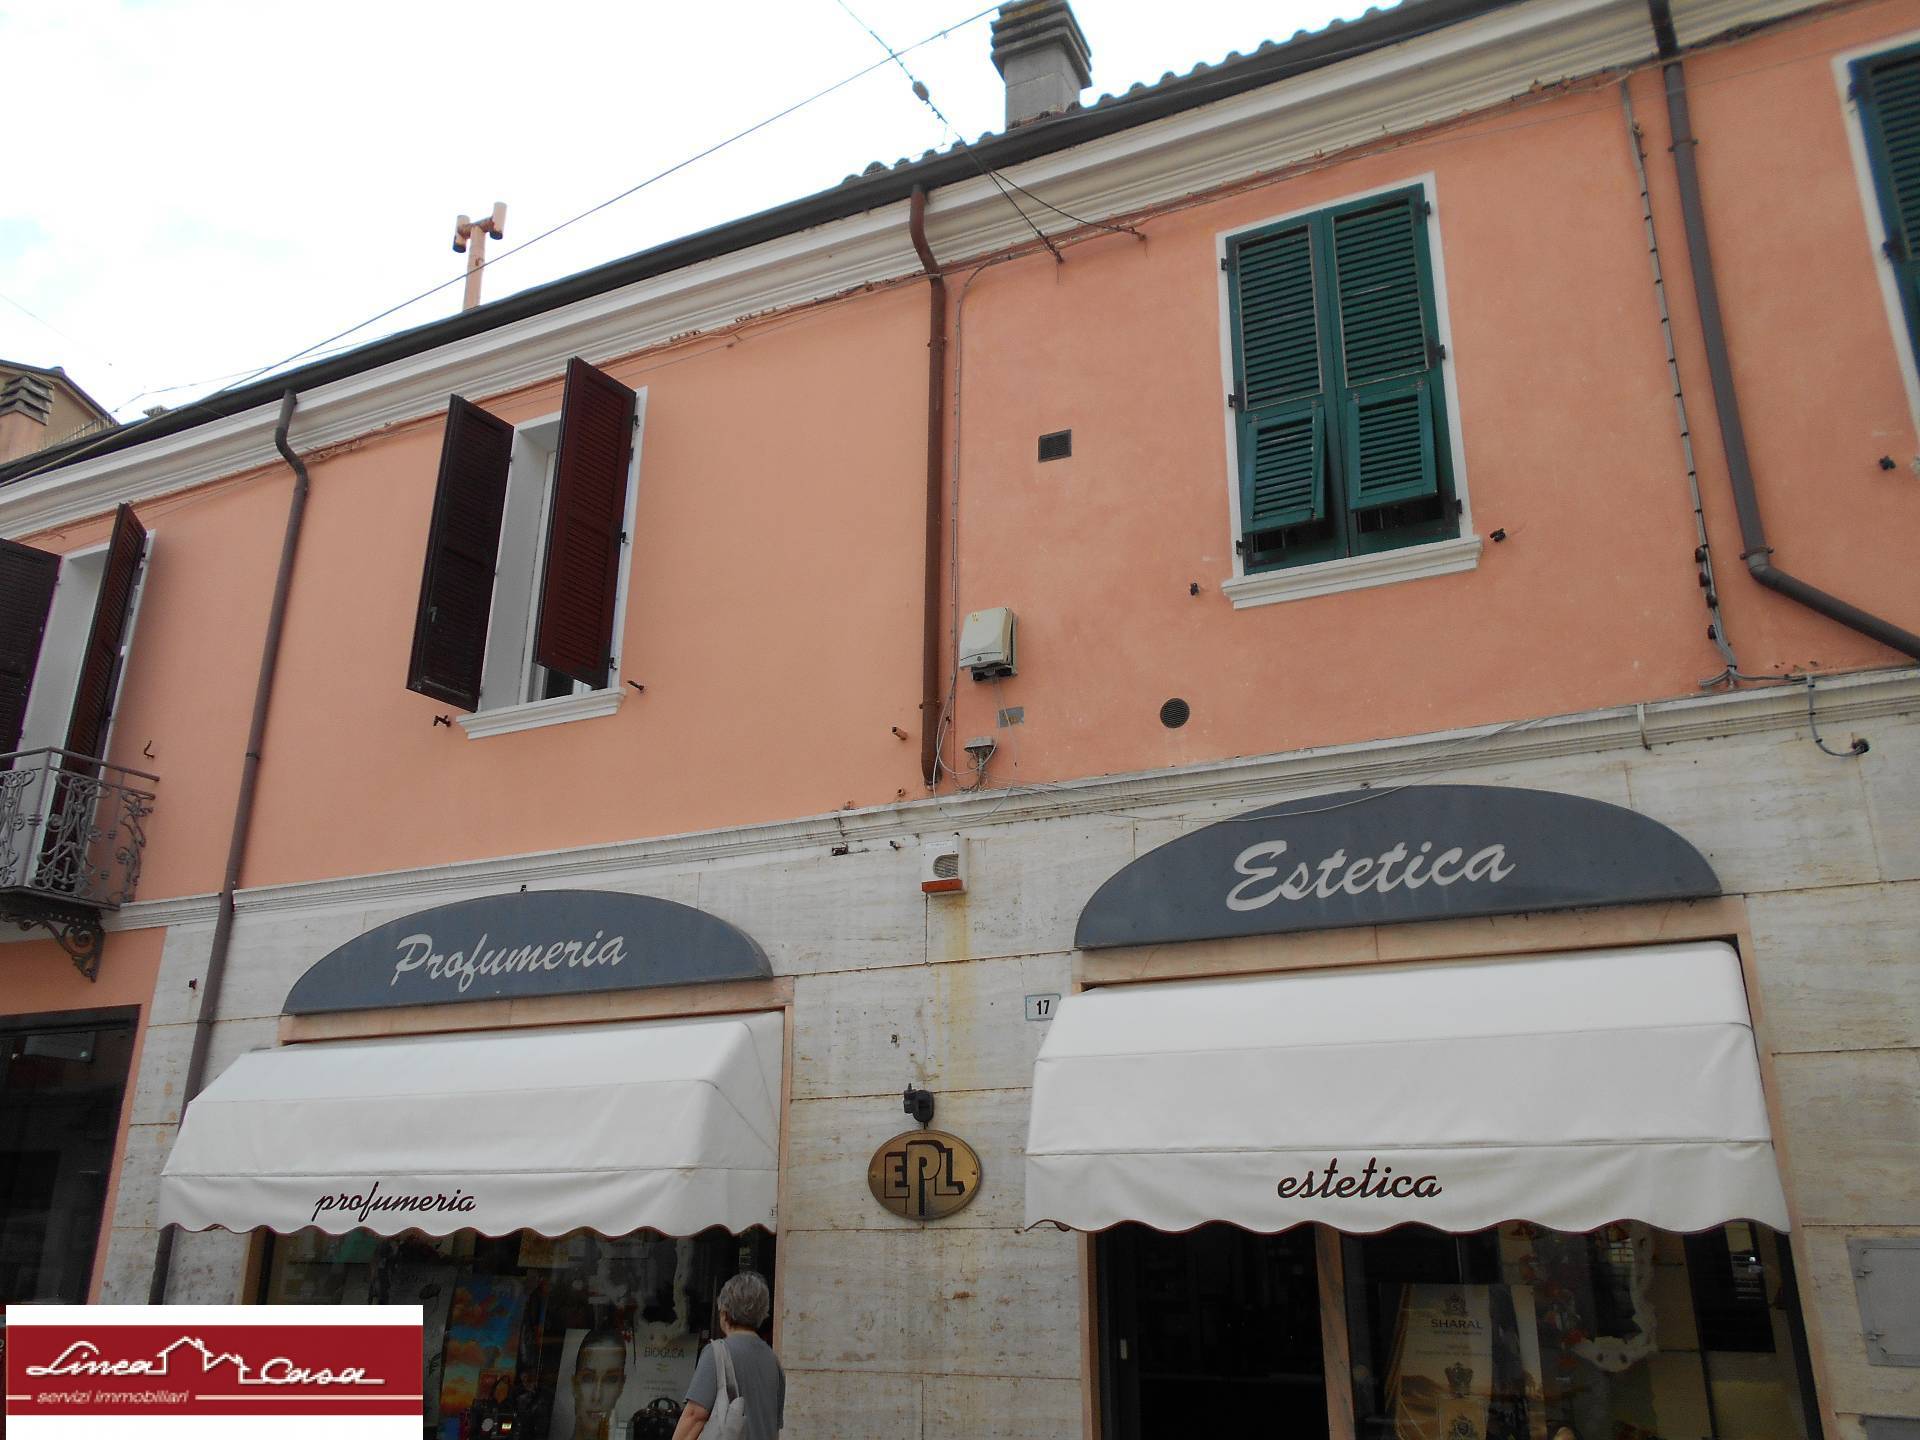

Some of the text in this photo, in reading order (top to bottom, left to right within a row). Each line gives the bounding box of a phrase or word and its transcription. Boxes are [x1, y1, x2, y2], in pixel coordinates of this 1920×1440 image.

[1226, 840, 1516, 911] Estetica
[390, 930, 628, 993] Profumeria
[1036, 999, 1050, 1015] 17
[311, 1181, 477, 1222] profumeria
[884, 1139, 966, 1217] EPL
[1277, 1156, 1443, 1199] estetica
